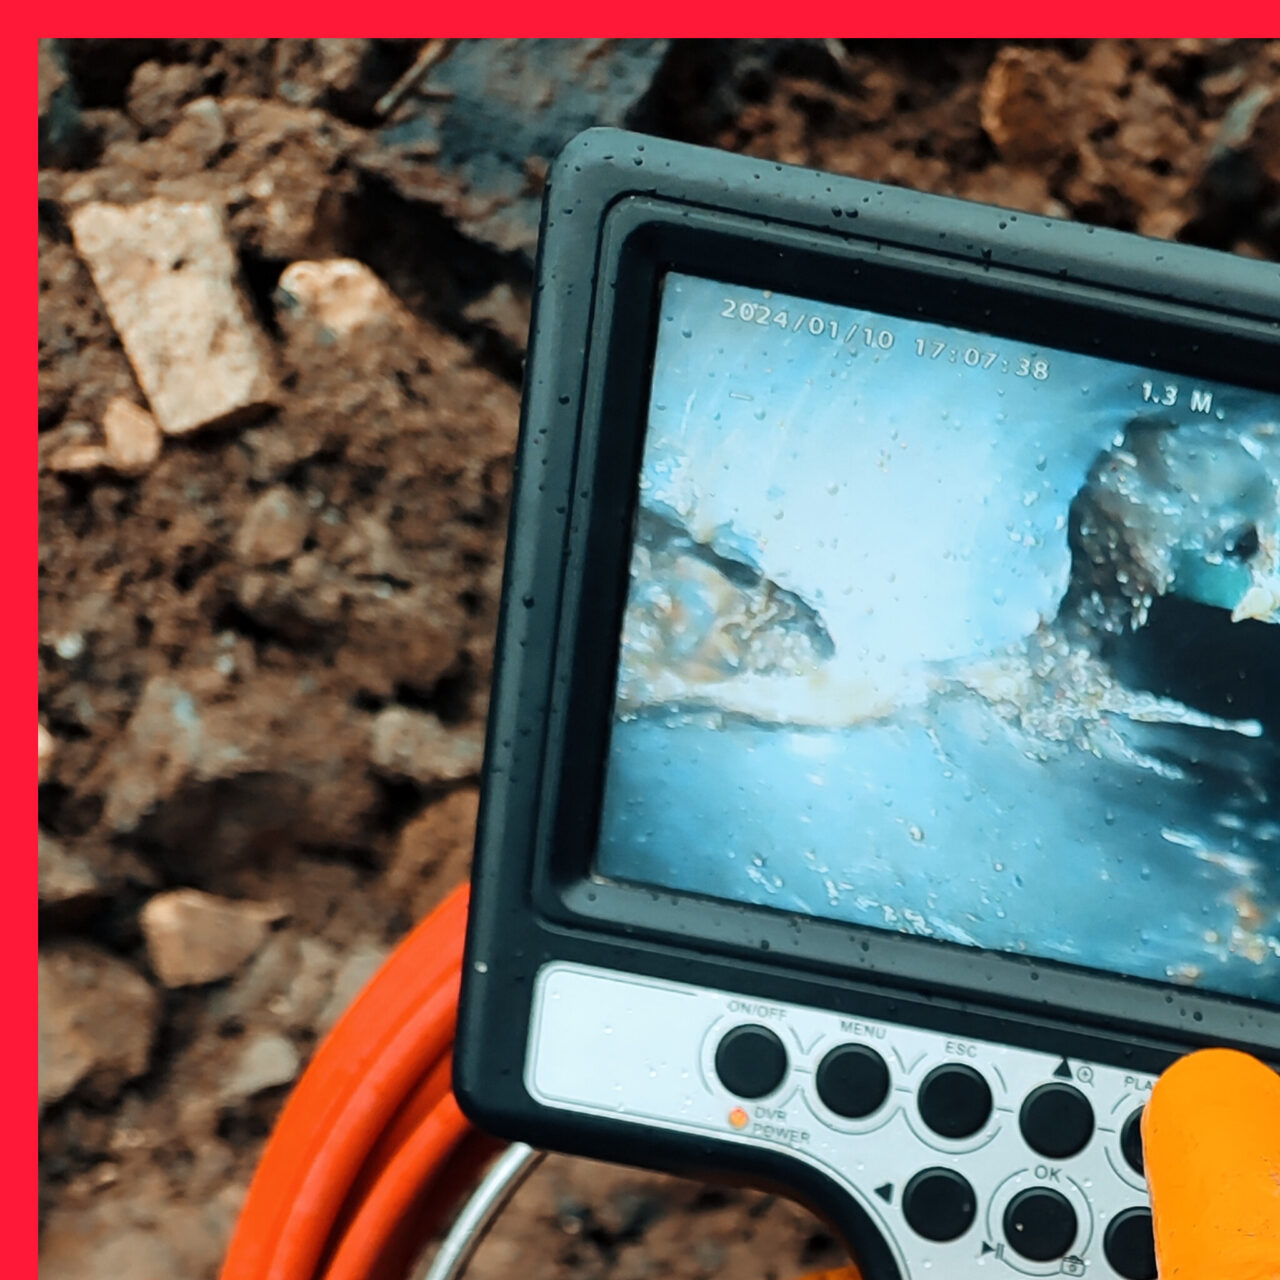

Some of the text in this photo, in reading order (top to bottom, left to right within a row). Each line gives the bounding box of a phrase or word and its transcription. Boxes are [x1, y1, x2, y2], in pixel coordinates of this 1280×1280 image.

[721, 298, 1050, 381] 2024/01/10 17:07:38
[1142, 381, 1214, 415] 1.3 M
[727, 1001, 788, 1021] ON/OFF
[840, 1019, 887, 1040] MENU
[945, 1041, 978, 1059] ESC
[1124, 1075, 1153, 1092] PLA
[754, 1105, 787, 1122] DVR
[752, 1123, 810, 1144] POWER
[1034, 1164, 1063, 1184] OK
